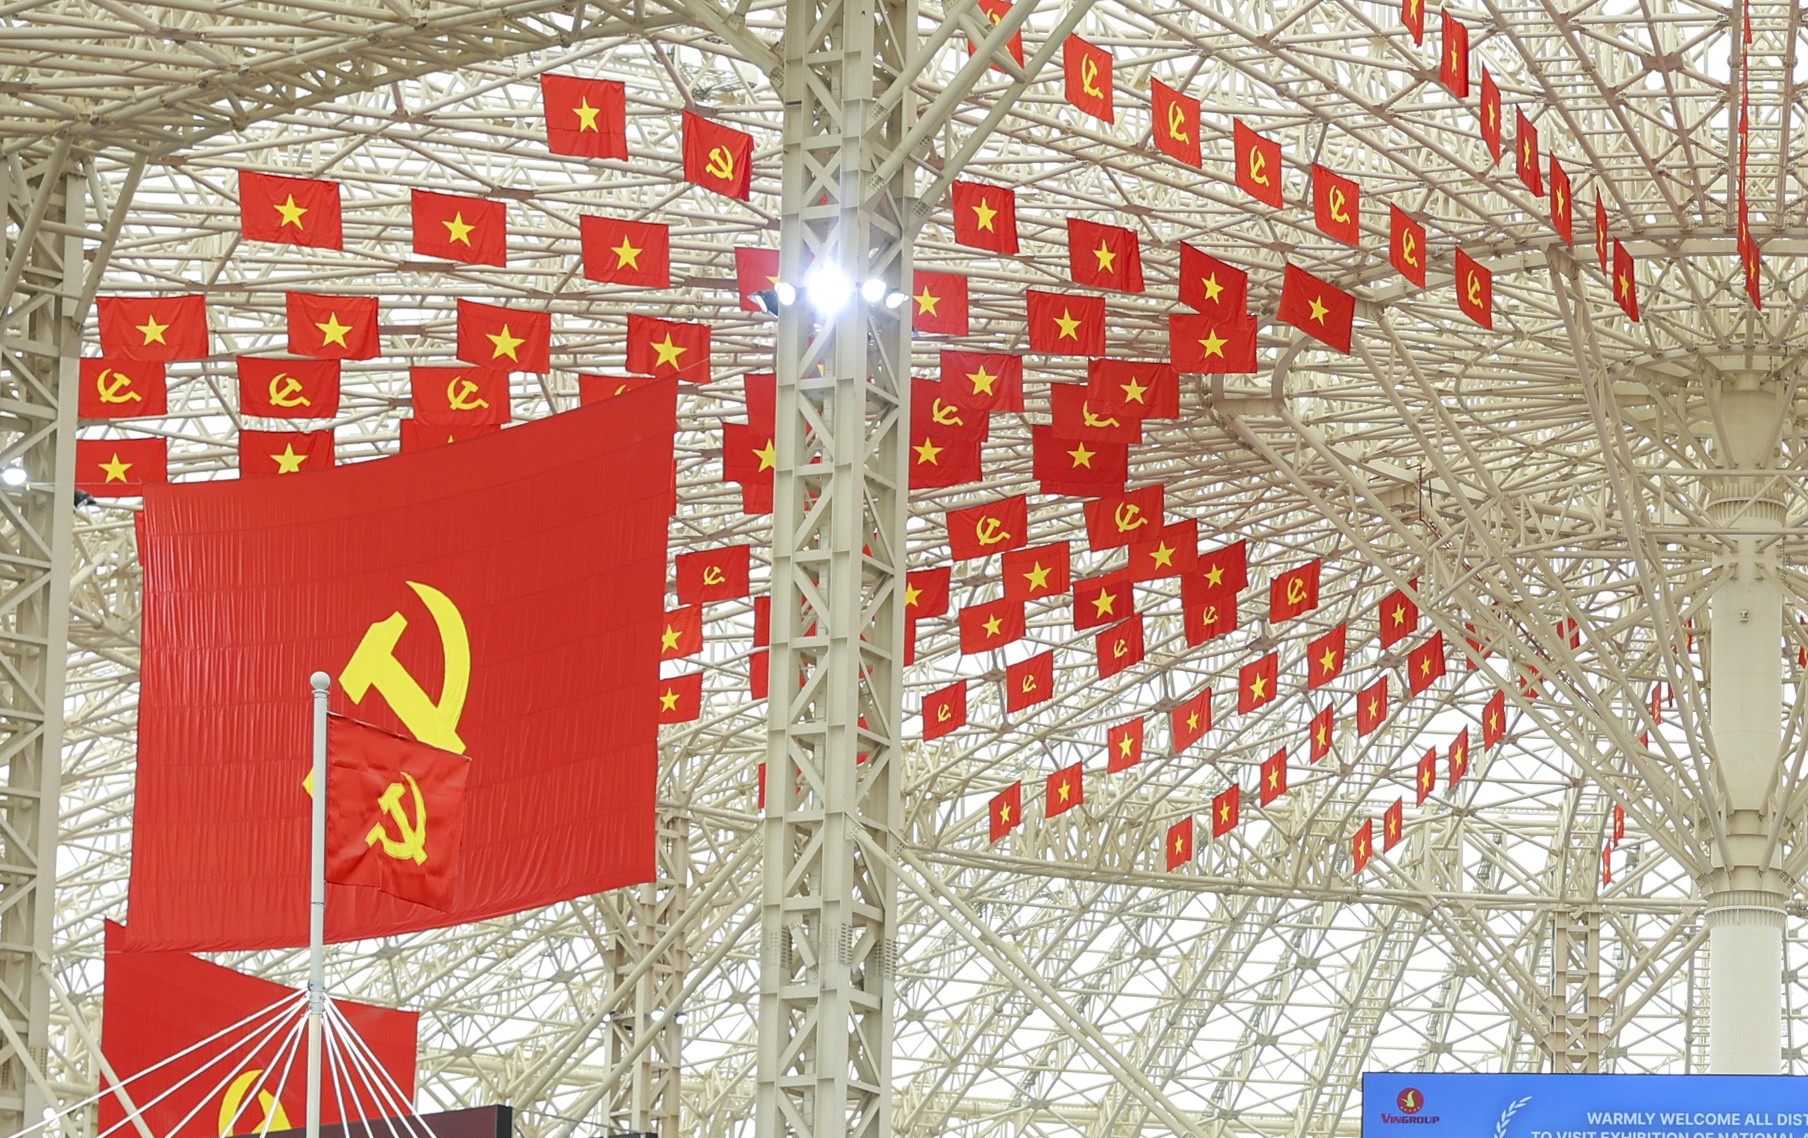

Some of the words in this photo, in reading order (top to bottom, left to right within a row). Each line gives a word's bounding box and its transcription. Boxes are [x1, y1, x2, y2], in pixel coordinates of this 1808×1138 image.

[1381, 1113, 1440, 1124] VINGROUP
[1586, 1112, 1656, 1125] WARMLY
[1659, 1113, 1740, 1126] WELCOME
[1744, 1113, 1773, 1126] ALL
